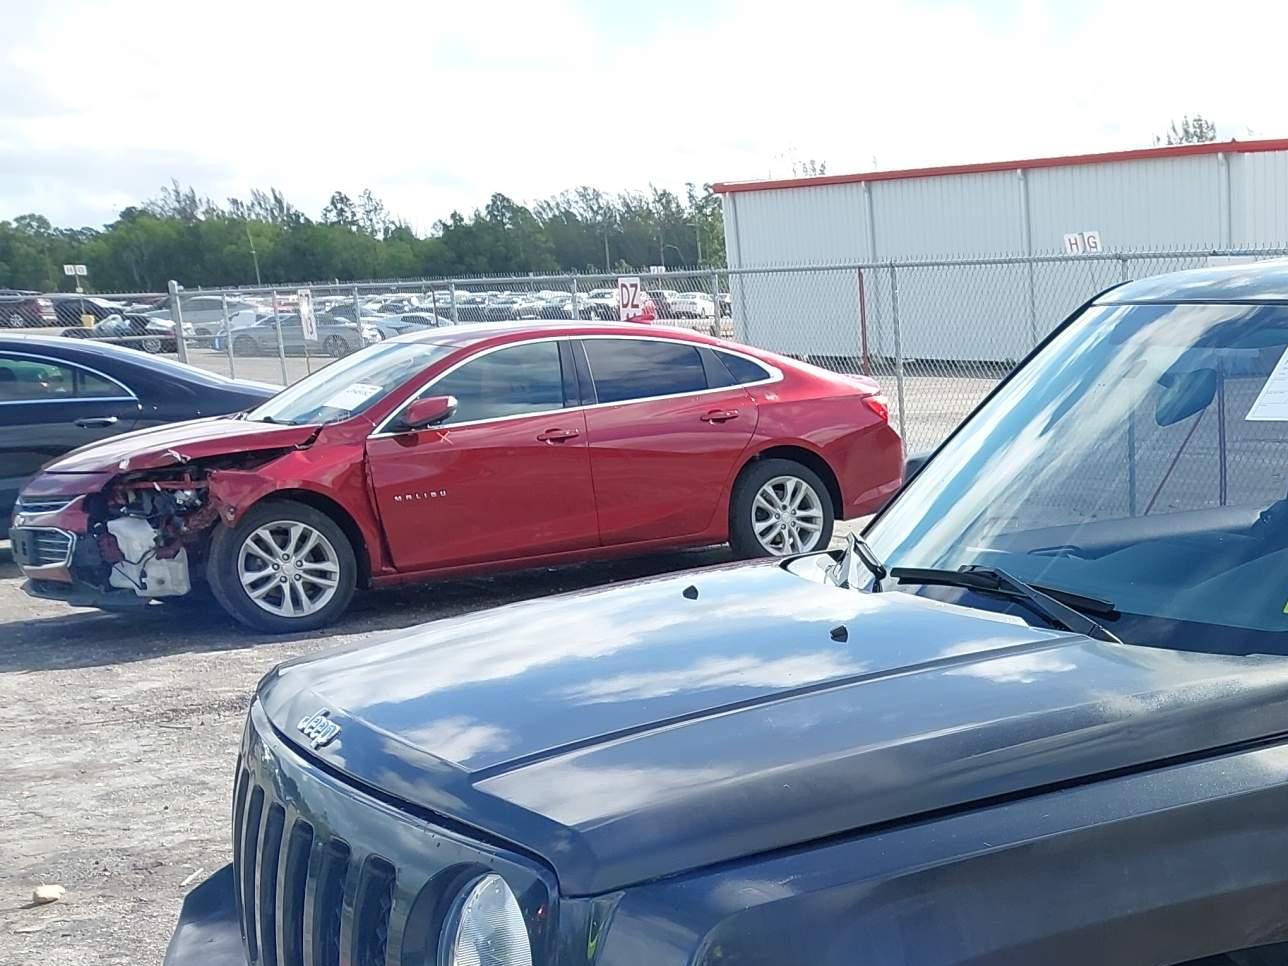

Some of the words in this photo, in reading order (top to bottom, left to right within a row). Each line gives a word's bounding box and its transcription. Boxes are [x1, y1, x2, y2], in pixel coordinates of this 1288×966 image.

[620, 283, 639, 308] DZ
[394, 490, 447, 501] MALIBU
[297, 707, 340, 749] Jeep
